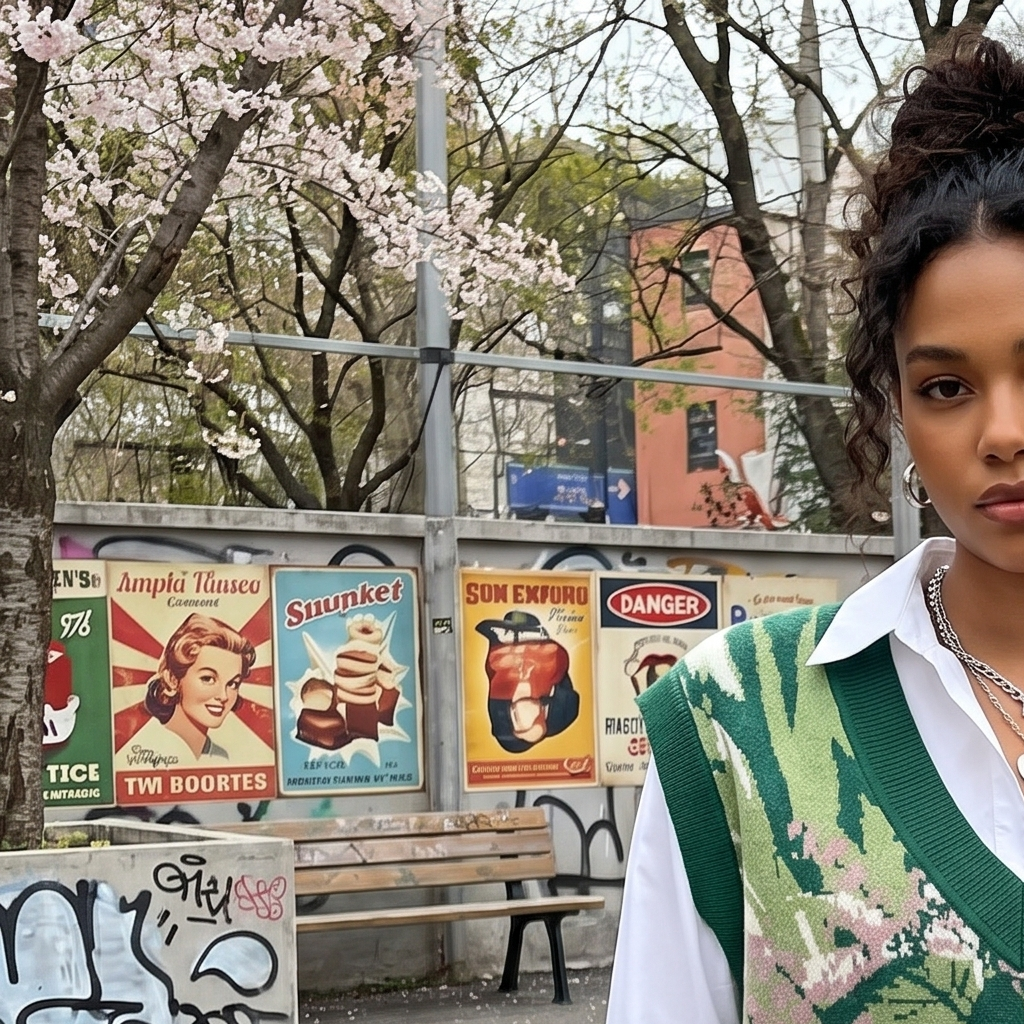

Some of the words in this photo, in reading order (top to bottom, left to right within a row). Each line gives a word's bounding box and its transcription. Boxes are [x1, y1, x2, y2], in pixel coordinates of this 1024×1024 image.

[620, 594, 699, 615] DANGER
[46, 763, 100, 783] TICE
[170, 772, 268, 794] BOORTES
